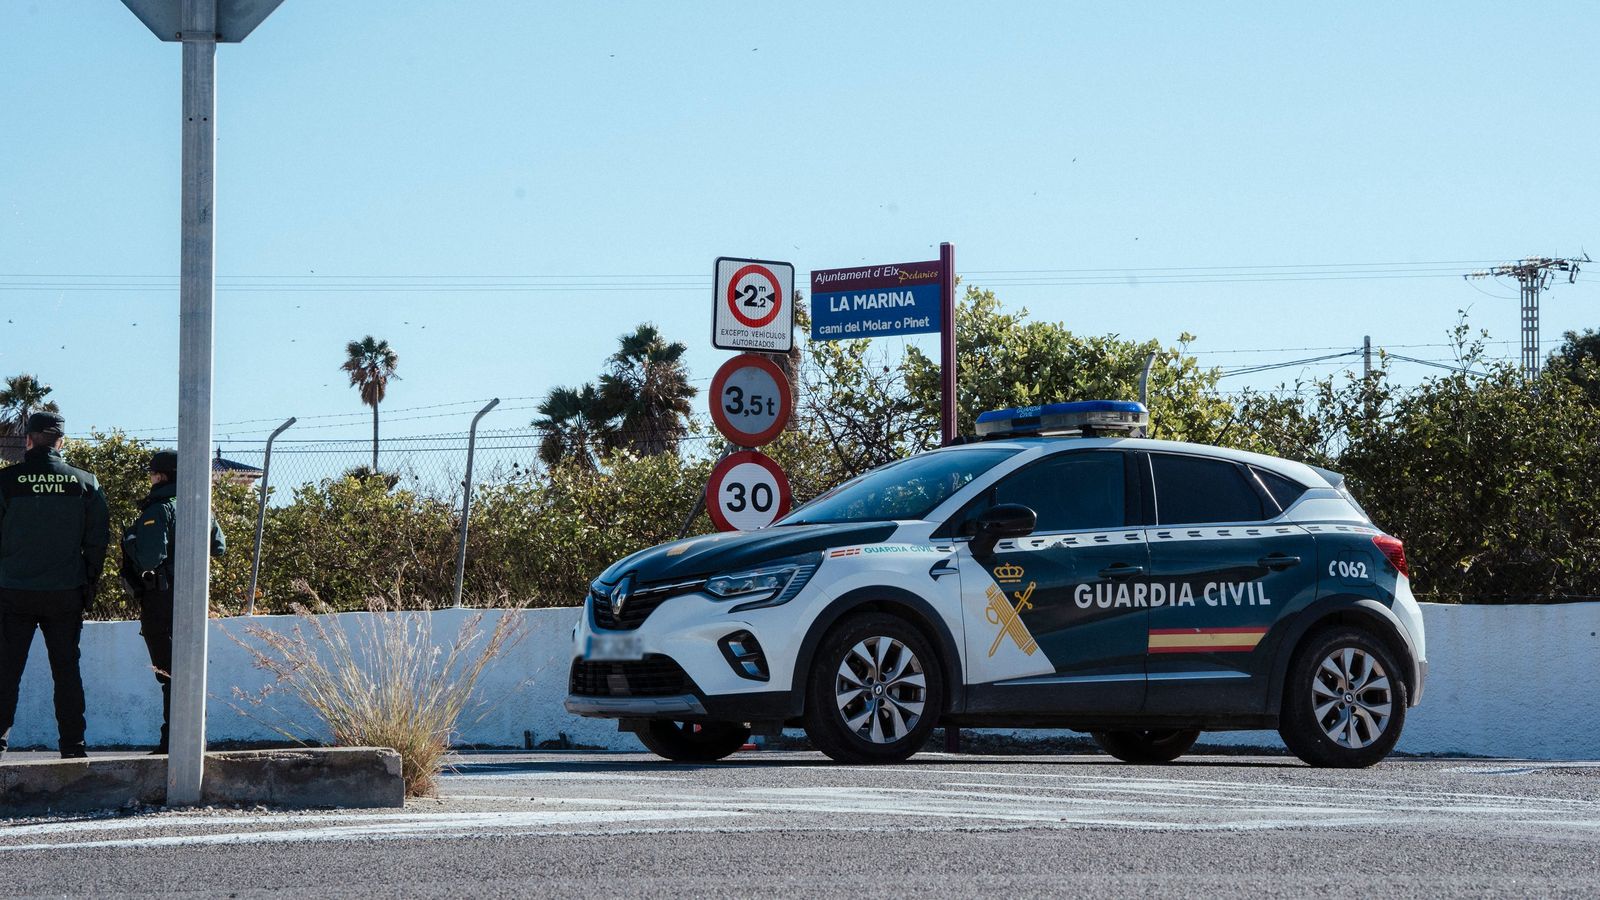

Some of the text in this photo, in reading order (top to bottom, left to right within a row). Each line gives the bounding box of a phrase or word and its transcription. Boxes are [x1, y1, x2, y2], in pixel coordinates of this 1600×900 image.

[815, 269, 871, 284] Ajuntament
[830, 291, 915, 312] LA MARINA
[845, 321, 860, 332] del
[862, 319, 892, 331] Molar
[894, 321, 901, 329] o
[903, 316, 930, 328] Pinet
[720, 329, 749, 337] EXCEPTO
[732, 339, 775, 348] AUTORIZADOS
[17, 474, 79, 483] GUARDIA
[32, 484, 65, 493] CIVIL
[726, 482, 773, 512] 30
[864, 545, 934, 554] GUARDIA CIVIL
[1074, 582, 1271, 609] GUARDIA CIVIL
